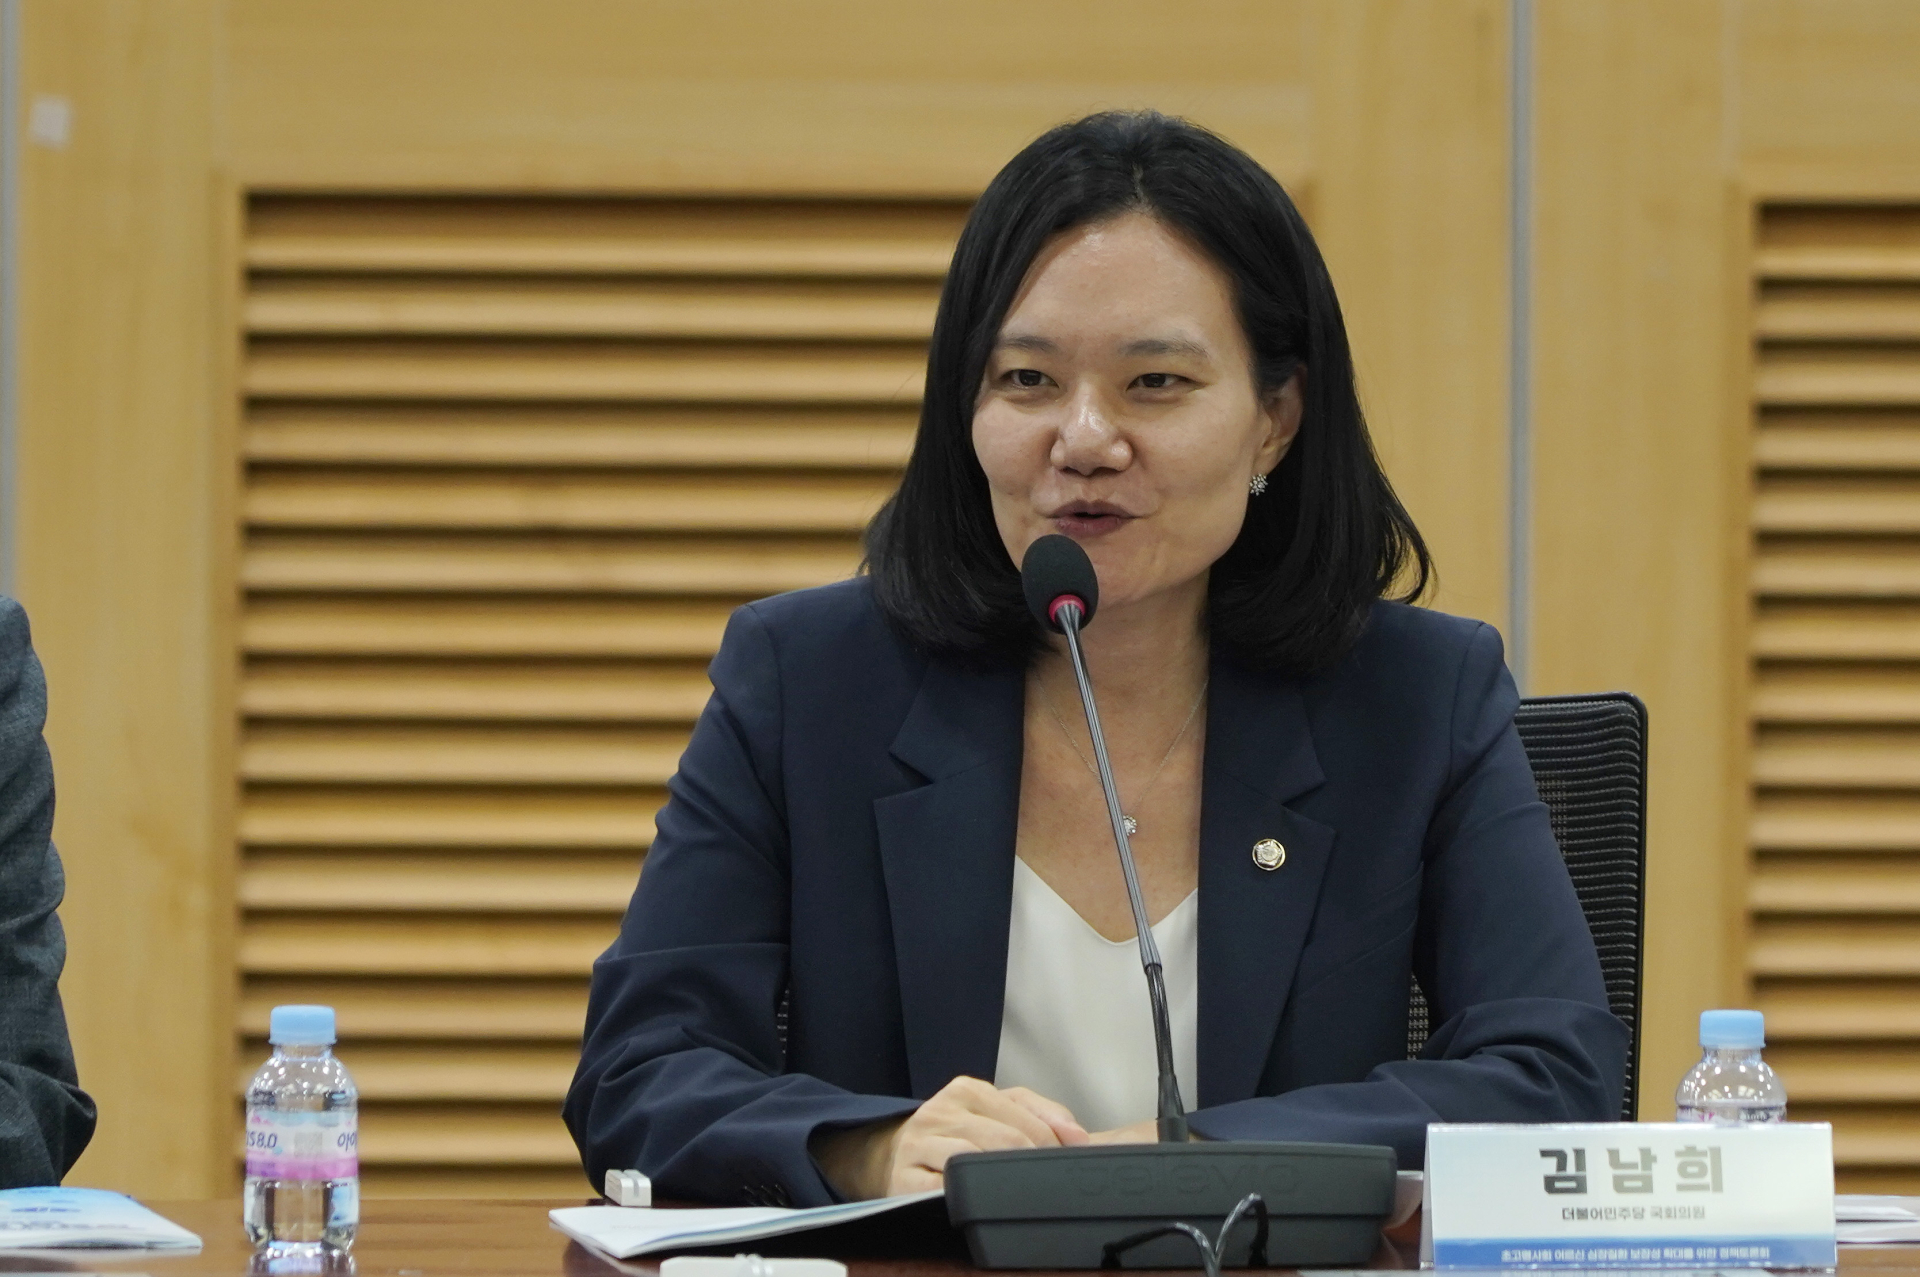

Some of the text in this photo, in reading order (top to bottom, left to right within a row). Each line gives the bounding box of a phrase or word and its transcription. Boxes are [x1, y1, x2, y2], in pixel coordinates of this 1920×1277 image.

[1539, 1145, 1723, 1195] 김남희
[1562, 1205, 1706, 1220] 더불어민주당 국회의원
